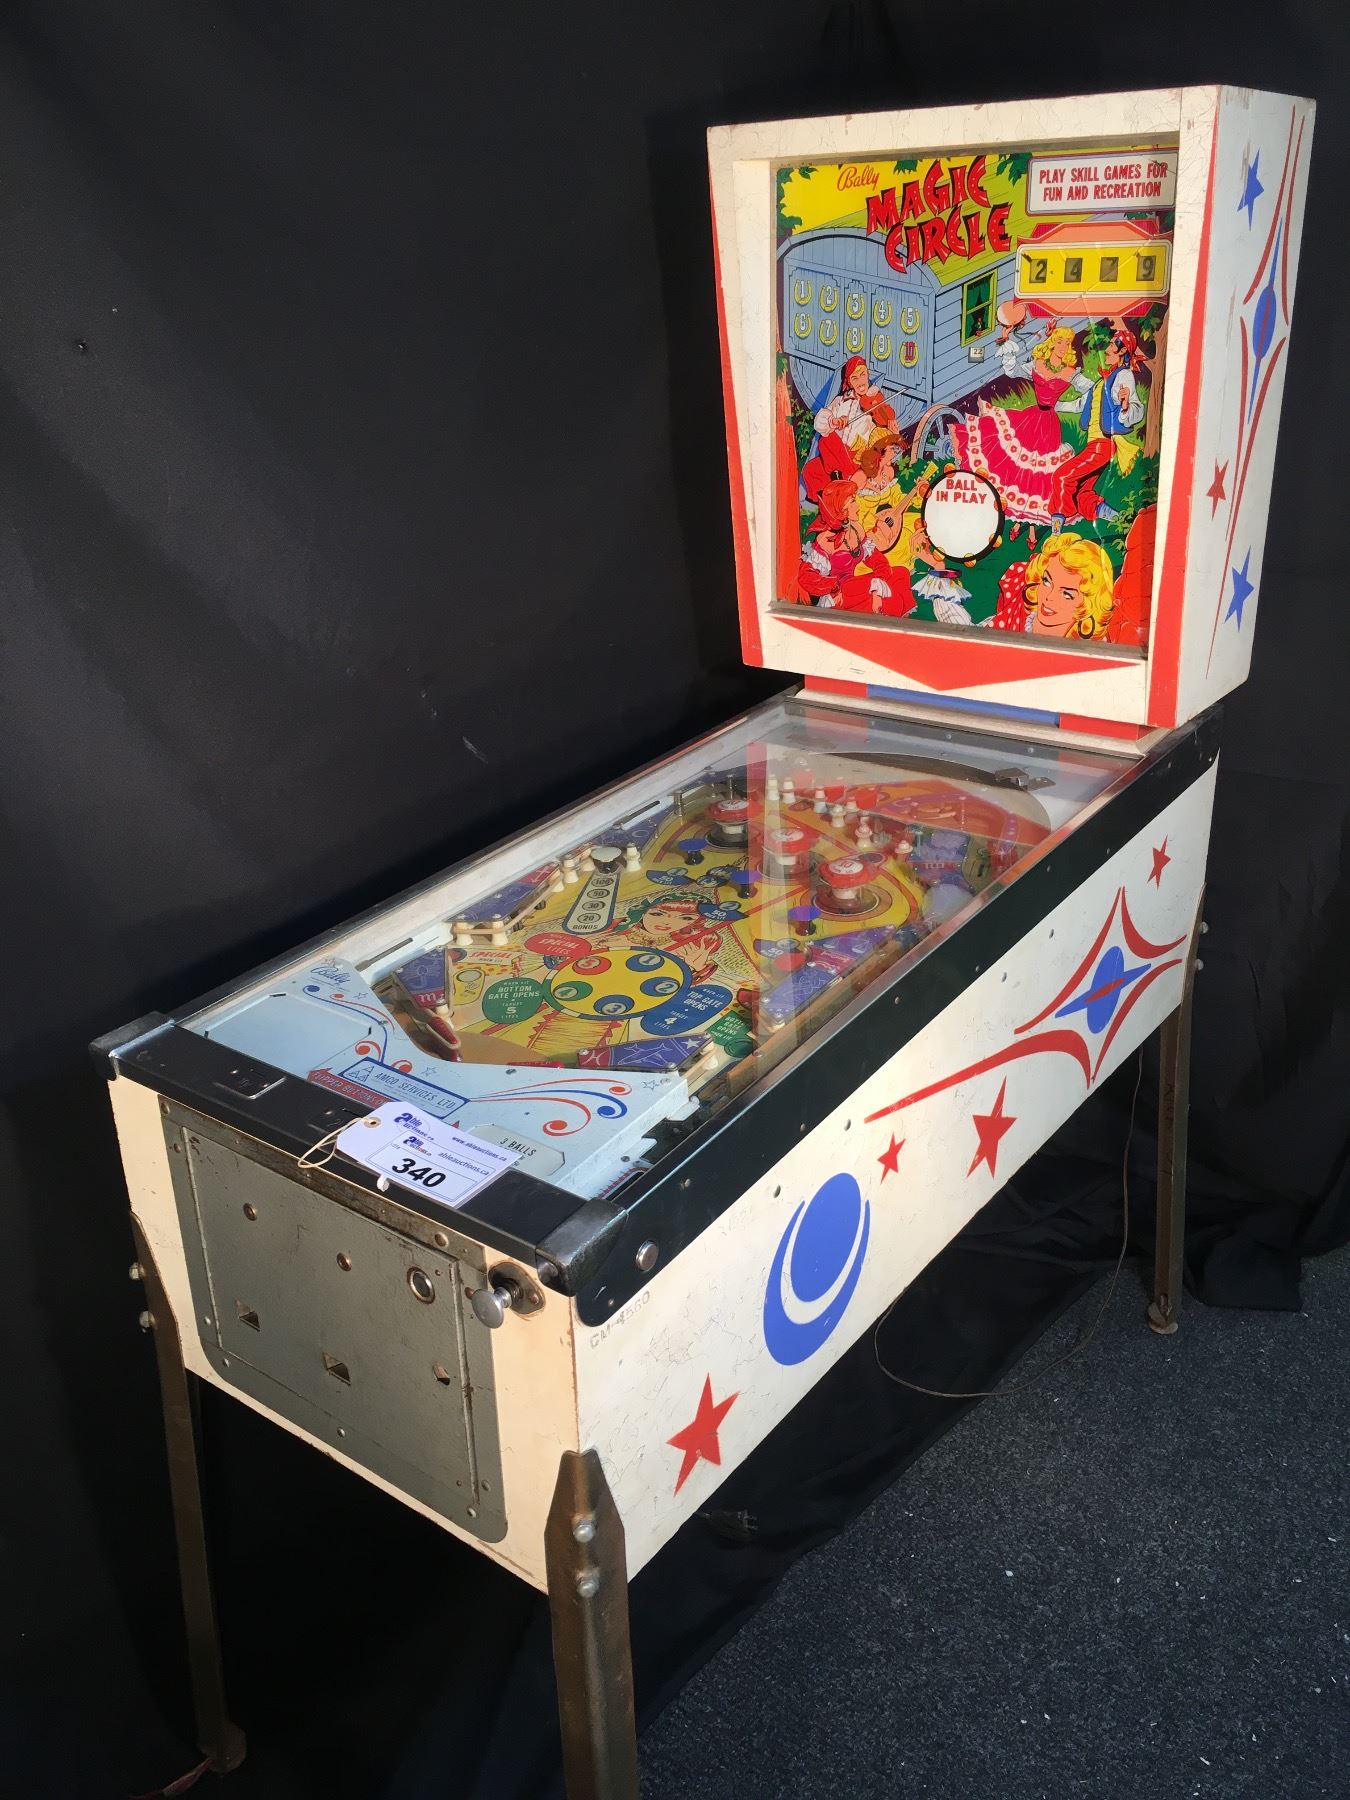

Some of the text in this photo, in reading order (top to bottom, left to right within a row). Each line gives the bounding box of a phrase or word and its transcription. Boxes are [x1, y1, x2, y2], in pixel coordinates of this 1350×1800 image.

[837, 165, 880, 191] Bally
[1039, 161, 1169, 184] PLAY SKILL GAMES FOR
[866, 155, 991, 237] MAGIC
[1043, 181, 1162, 202] FUN AND RECREATION
[884, 203, 1013, 274] CIRCLE
[1035, 260, 1047, 282] 2
[1070, 259, 1082, 281] 4
[1142, 256, 1155, 279] 9
[799, 279, 915, 327] 1 2 3 4 5
[799, 312, 916, 362] 6 7 8 9 10
[973, 347, 984, 355] 22
[945, 479, 978, 491] BALL
[936, 490, 988, 504] IN PLAY
[593, 889, 605, 898] 50
[587, 902, 599, 910] 30
[583, 914, 595, 922] 20
[538, 938, 580, 949] SPECIAL
[469, 951, 513, 959] SPECIAL
[581, 958, 594, 969] 5
[310, 966, 351, 986] Bally
[660, 983, 675, 993] 2
[488, 991, 541, 1000] GATE OPENS
[687, 991, 723, 1009] TOP GATE
[608, 1003, 621, 1013] 3
[683, 998, 708, 1011] OPENS
[664, 1017, 678, 1025] 4
[670, 1010, 689, 1020] TARGET
[717, 1025, 738, 1036] OPENS
[375, 1072, 456, 1109] AMCO SERVICES LTD
[508, 1140, 537, 1157] BALLS
[437, 1151, 490, 1176] ableauctions.ca
[391, 1157, 447, 1188] 340
